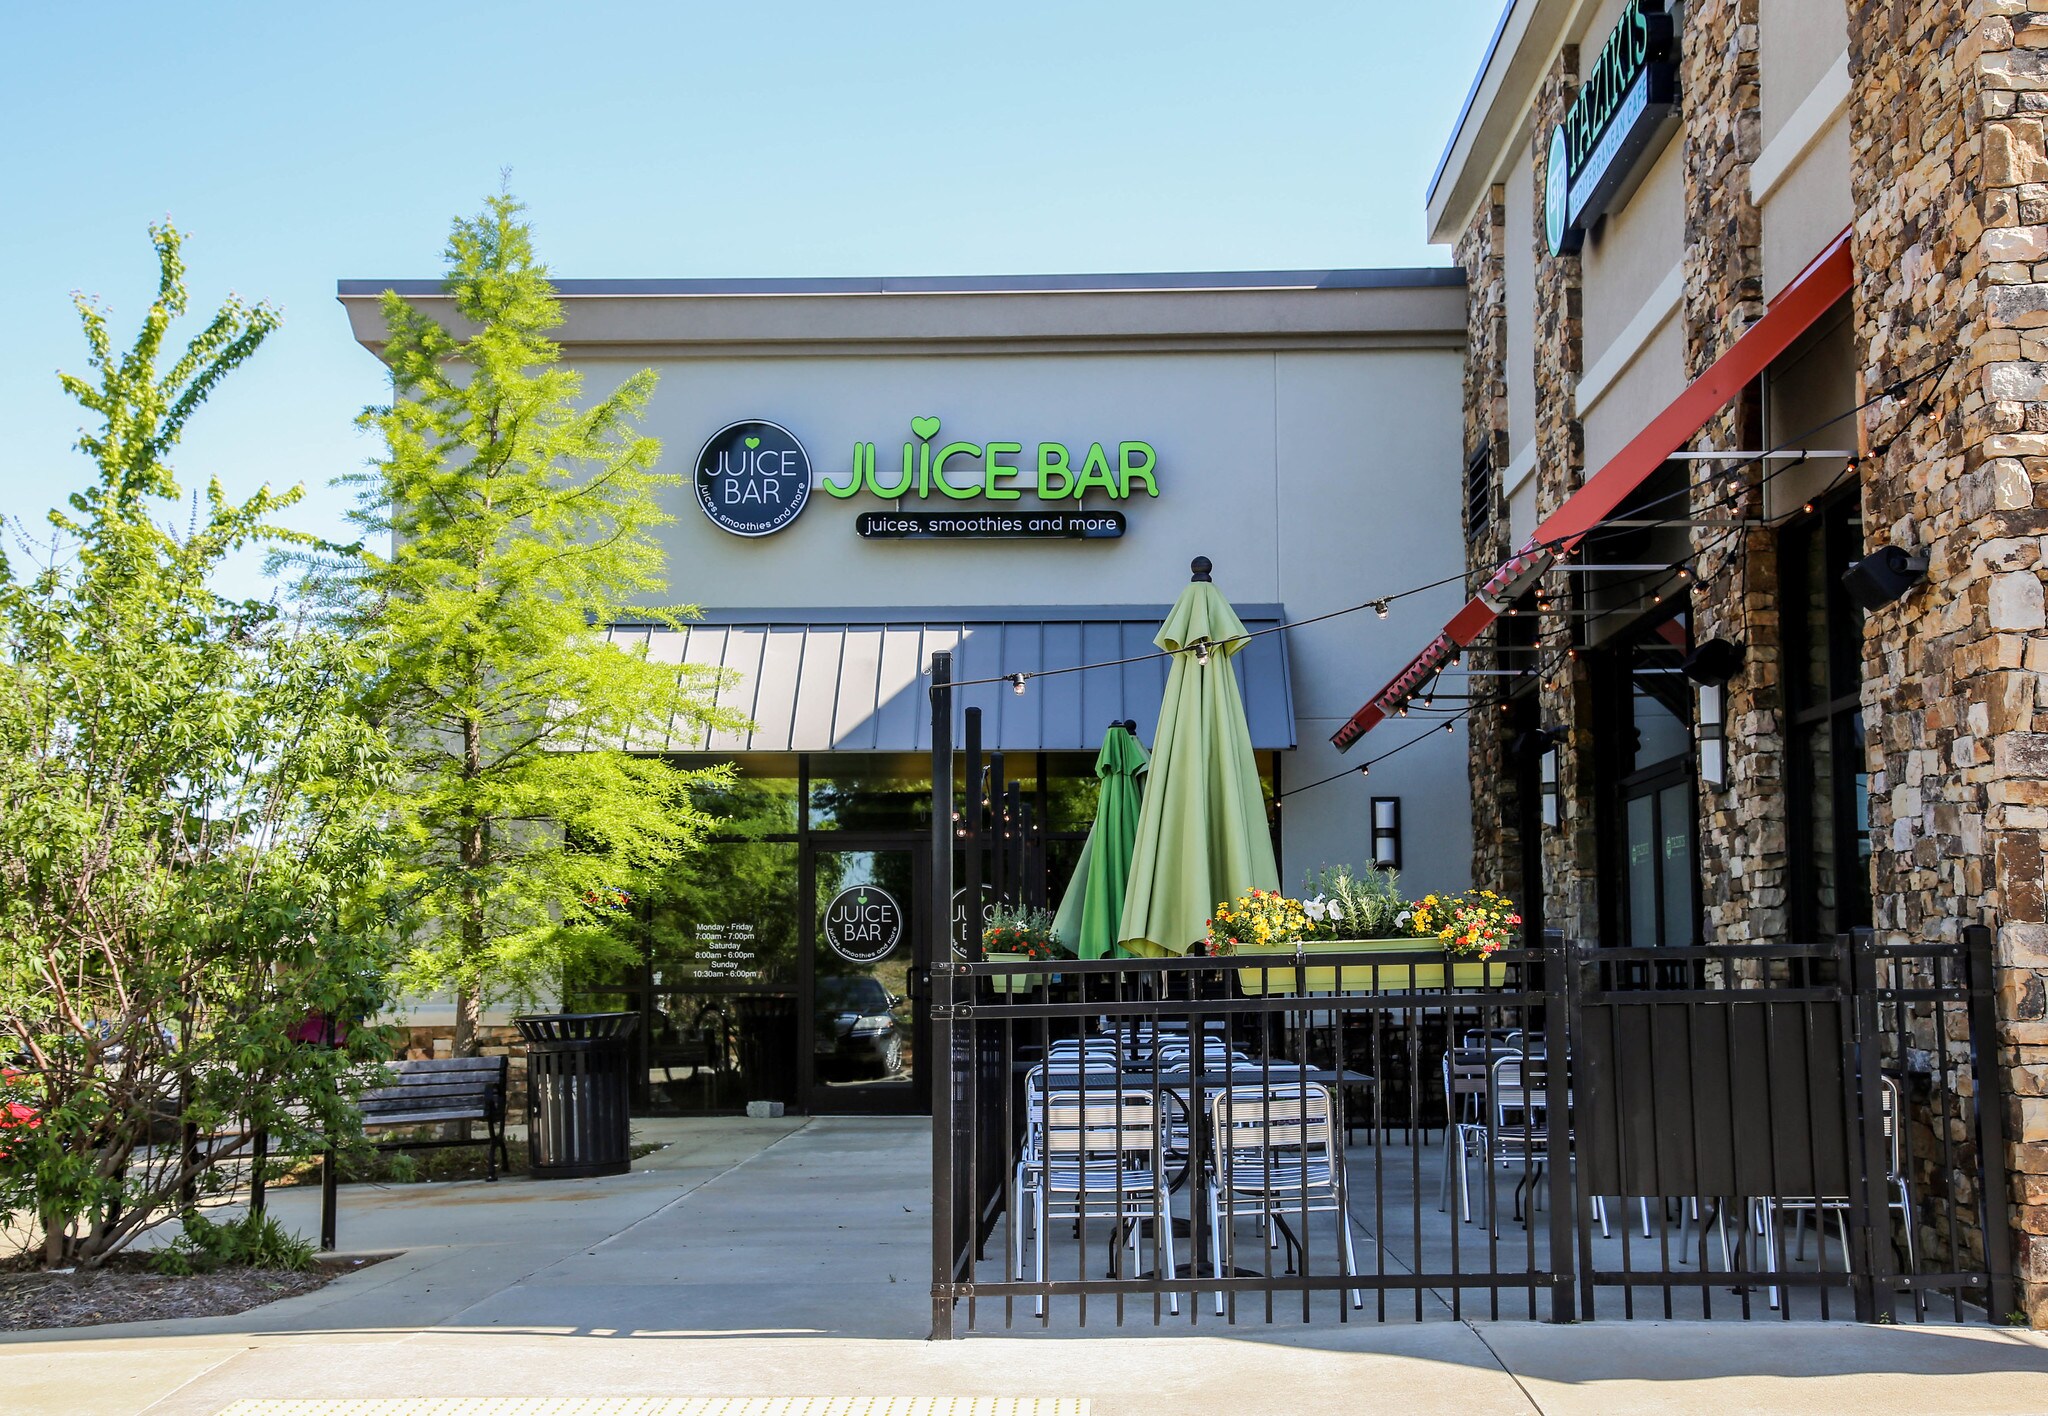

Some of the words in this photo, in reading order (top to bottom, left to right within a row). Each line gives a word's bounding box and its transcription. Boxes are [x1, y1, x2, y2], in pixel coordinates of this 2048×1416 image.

[704, 450, 797, 477] JUICE
[822, 440, 1022, 500] JUICE
[1037, 440, 1160, 500] BAR
[724, 478, 781, 505] BAR
[698, 483, 719, 516] juices,
[719, 513, 772, 531] smoothies
[773, 507, 791, 525] and
[790, 482, 806, 510] more
[865, 516, 923, 536] juices,
[928, 515, 1023, 532] smoothies
[1031, 515, 1063, 531] and
[1068, 517, 1118, 532] more
[831, 904, 893, 923] JUICE
[695, 932, 722, 940] 7:00am
[728, 932, 755, 941] 7:00pm
[696, 923, 726, 932] Monday
[731, 923, 754, 932] Friday
[844, 923, 882, 941] BAR
[708, 942, 741, 951] Saturday
[841, 946, 876, 959] smoothies
[876, 942, 889, 954] and
[887, 926, 898, 944] more
[694, 951, 722, 959] 8:00am
[727, 951, 755, 960] 6:00pm
[711, 960, 739, 970] Sunday
[693, 970, 724, 978] 10:30am
[729, 970, 757, 979] 6:00pm
